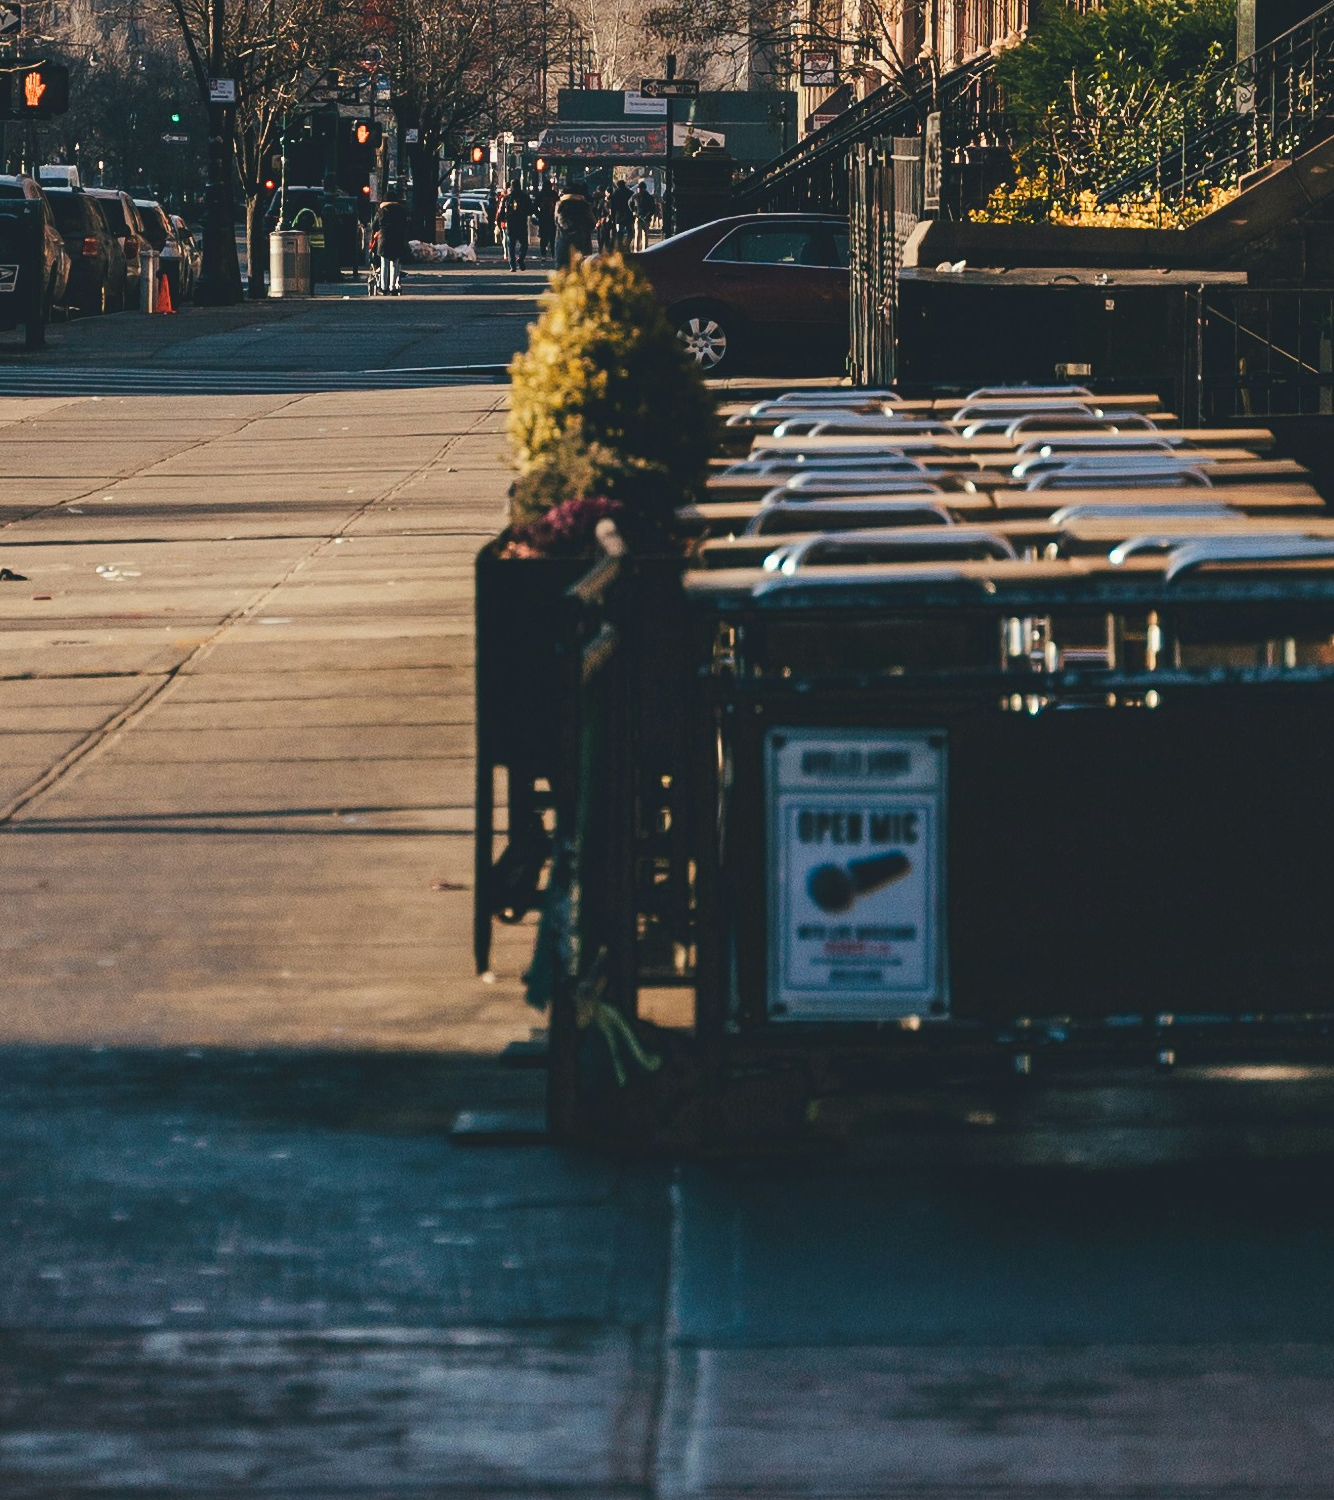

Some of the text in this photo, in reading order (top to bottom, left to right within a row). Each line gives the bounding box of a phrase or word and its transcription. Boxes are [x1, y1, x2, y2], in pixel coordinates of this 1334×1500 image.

[599, 134, 618, 144] Gift
[619, 134, 646, 143] Store
[797, 811, 919, 845] OPEN MIC
